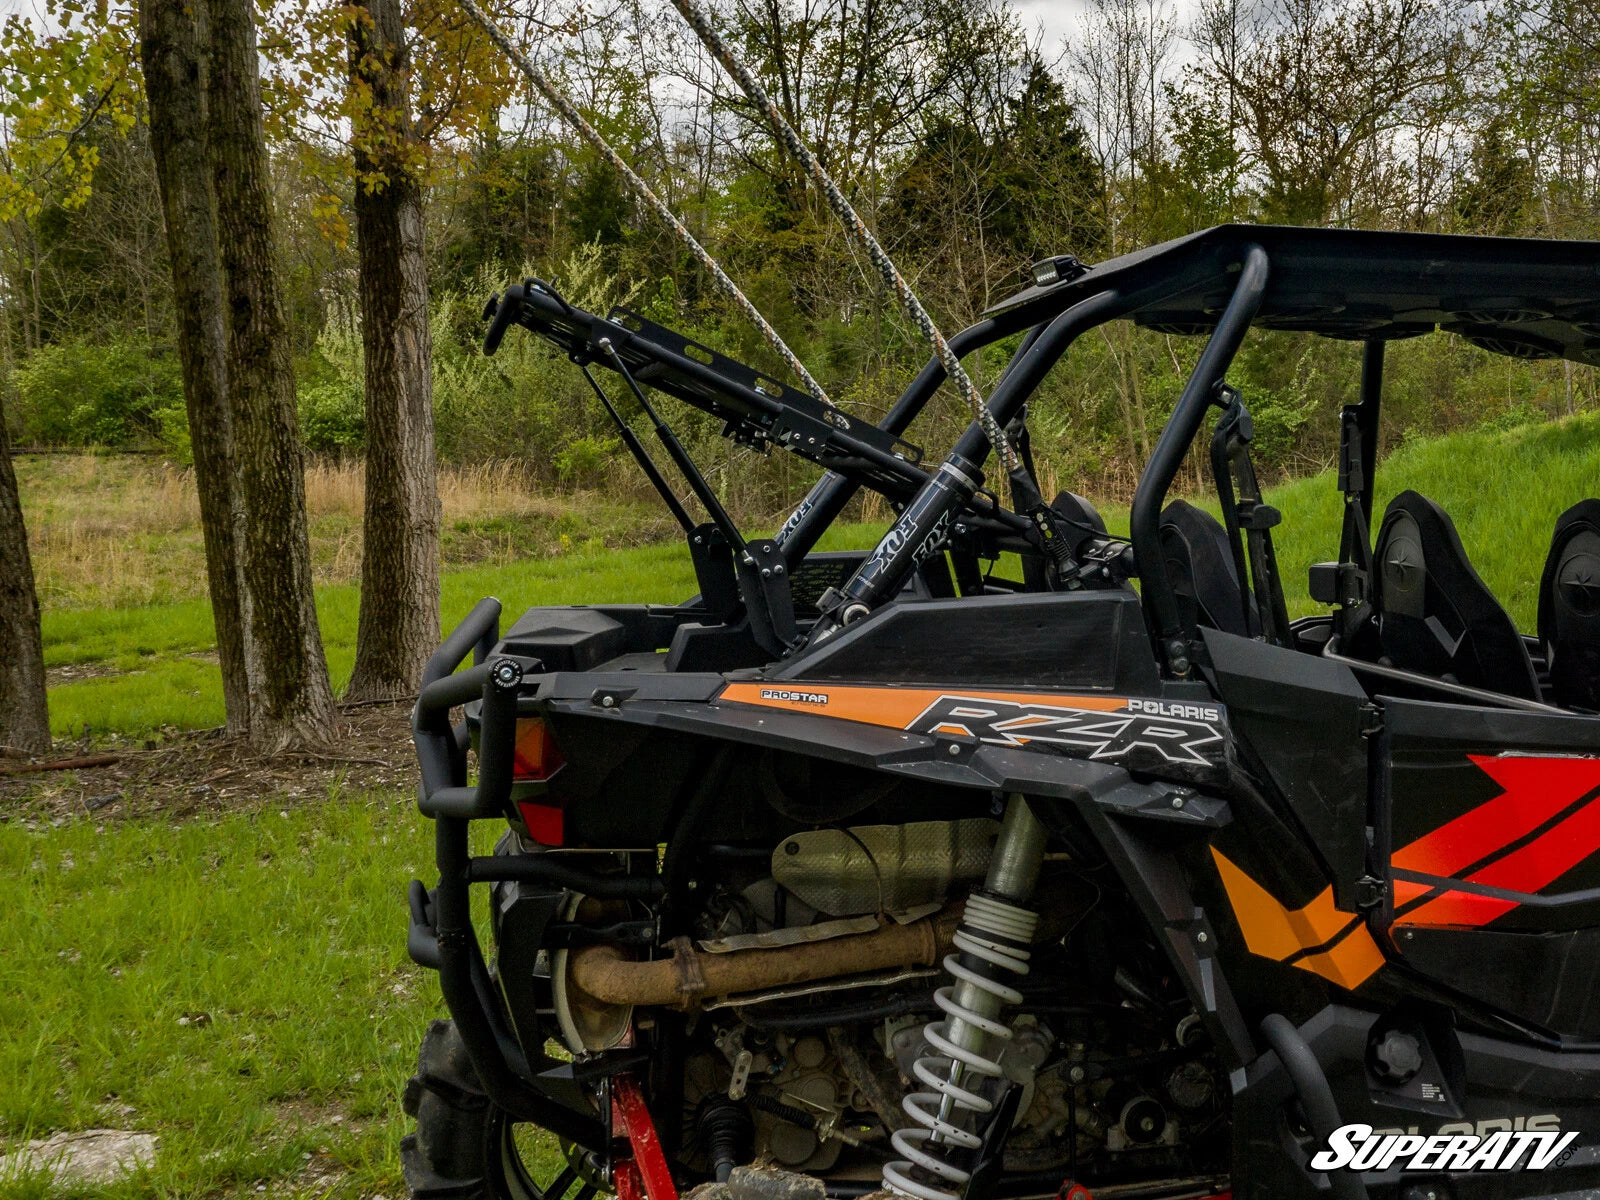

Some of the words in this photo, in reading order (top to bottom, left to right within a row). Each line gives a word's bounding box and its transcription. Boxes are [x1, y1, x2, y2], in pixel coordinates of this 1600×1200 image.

[777, 498, 813, 544] FOX
[867, 513, 918, 574] FOX
[912, 509, 950, 568] FOX
[760, 689, 829, 704] PROSTAR
[1127, 699, 1219, 721] POLARIS
[904, 695, 1223, 767] RZR
